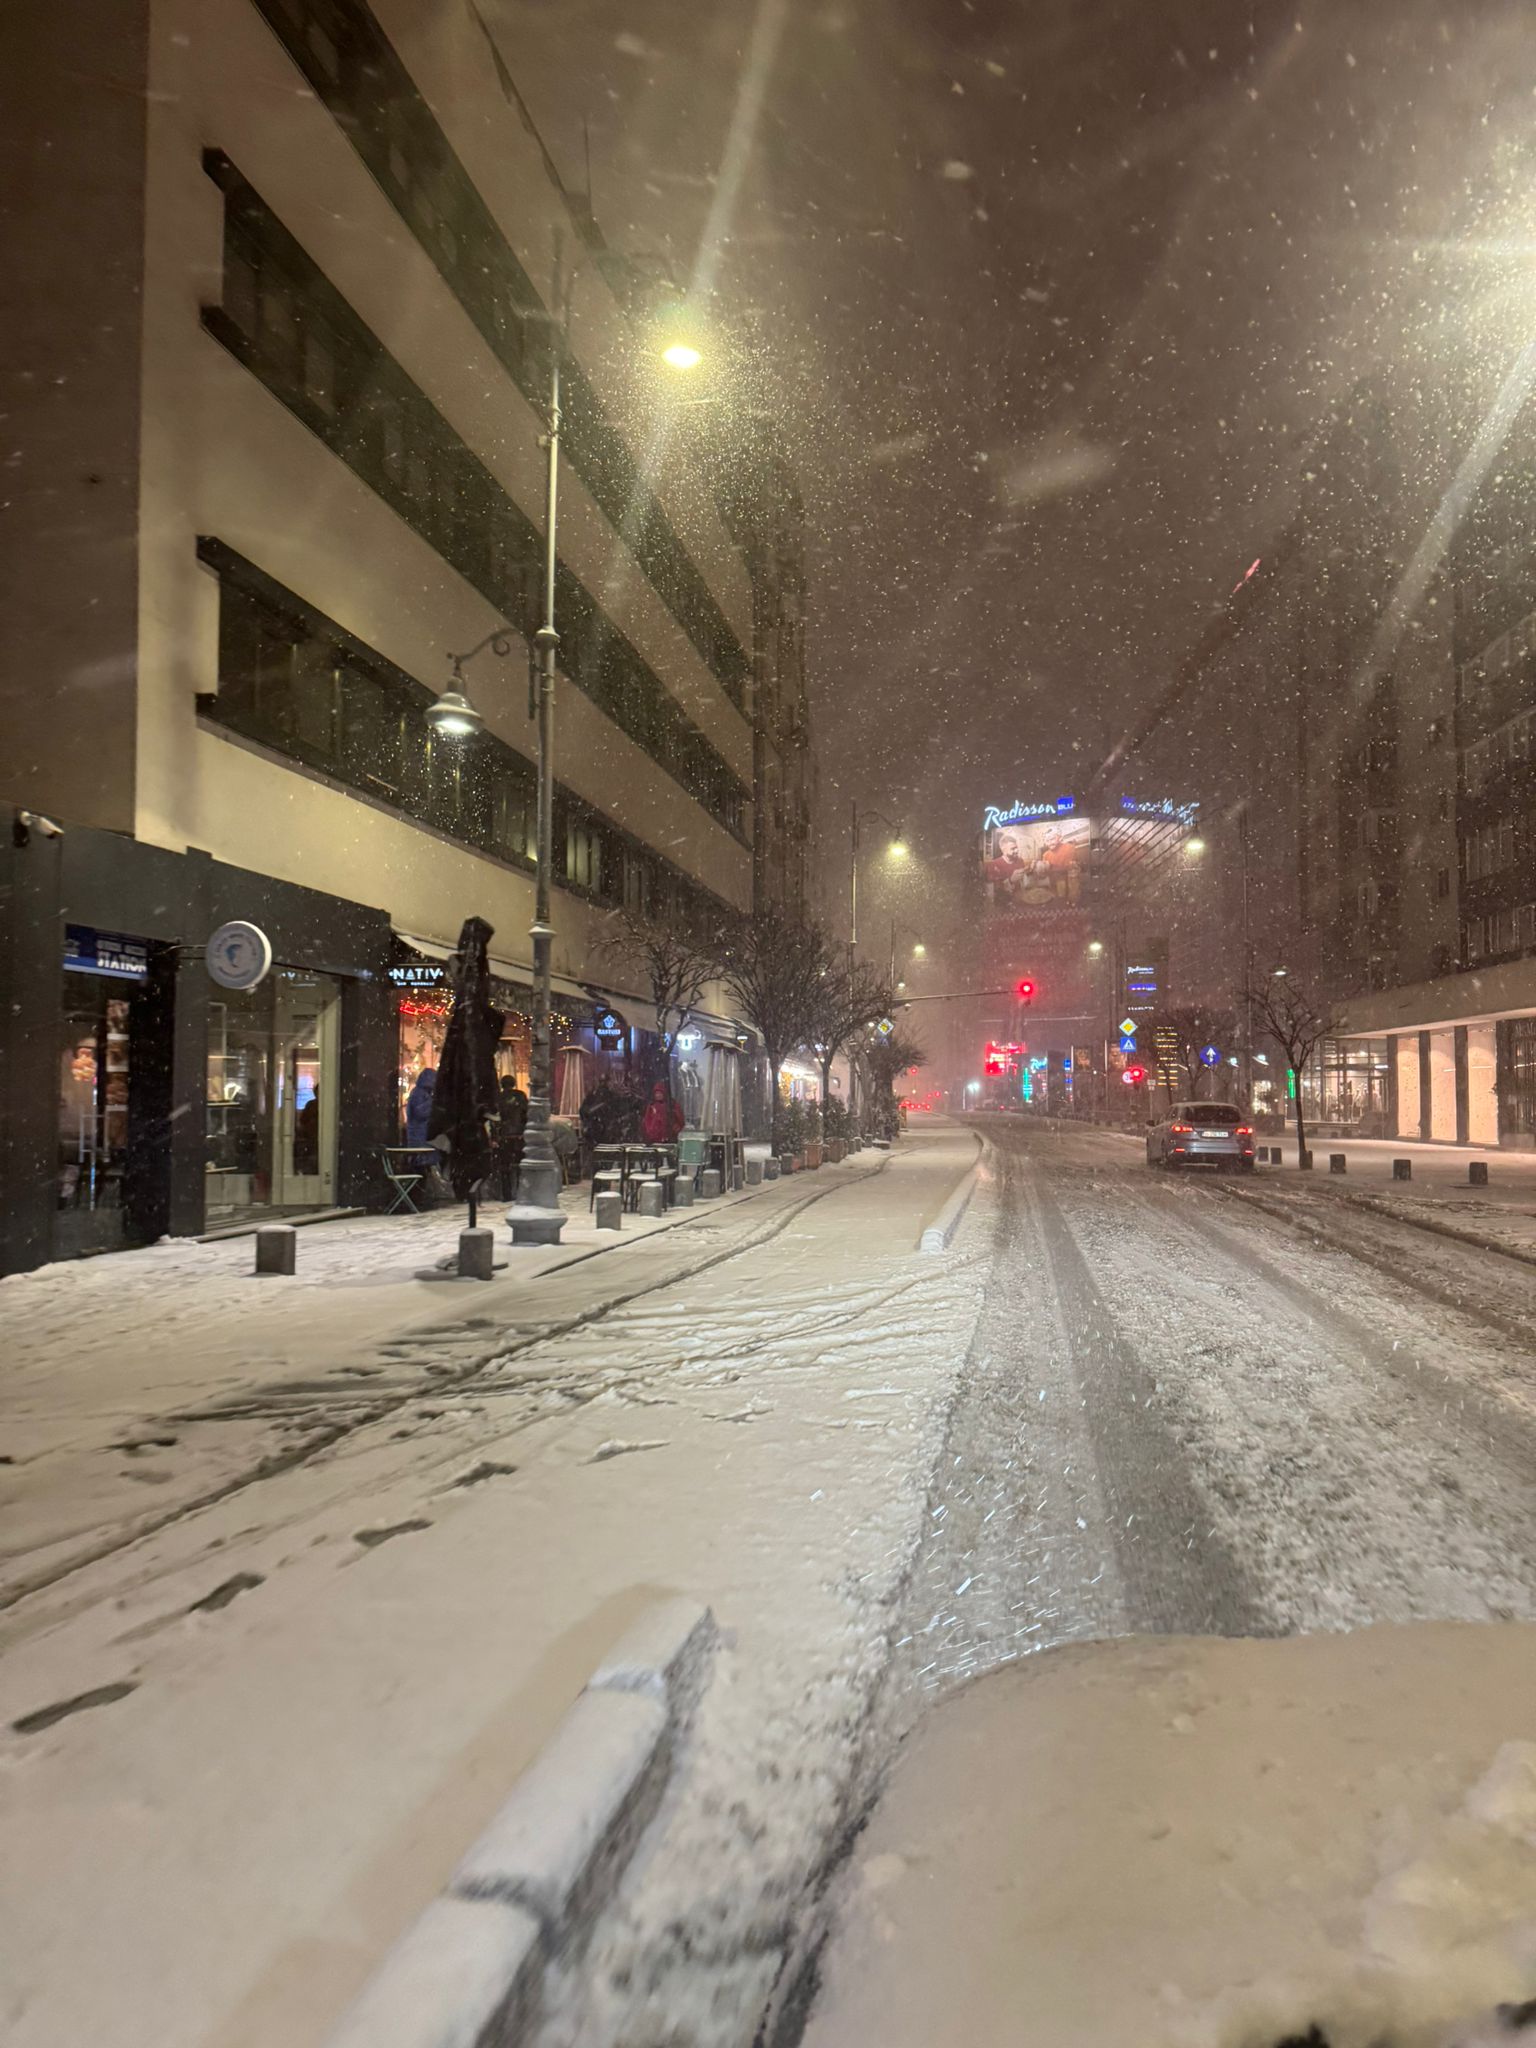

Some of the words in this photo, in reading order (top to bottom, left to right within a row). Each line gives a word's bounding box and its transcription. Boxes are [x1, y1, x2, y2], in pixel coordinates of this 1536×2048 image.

[984, 799, 1056, 831] Radisson
[1057, 803, 1074, 811] BLU
[393, 967, 441, 980] NATIV
